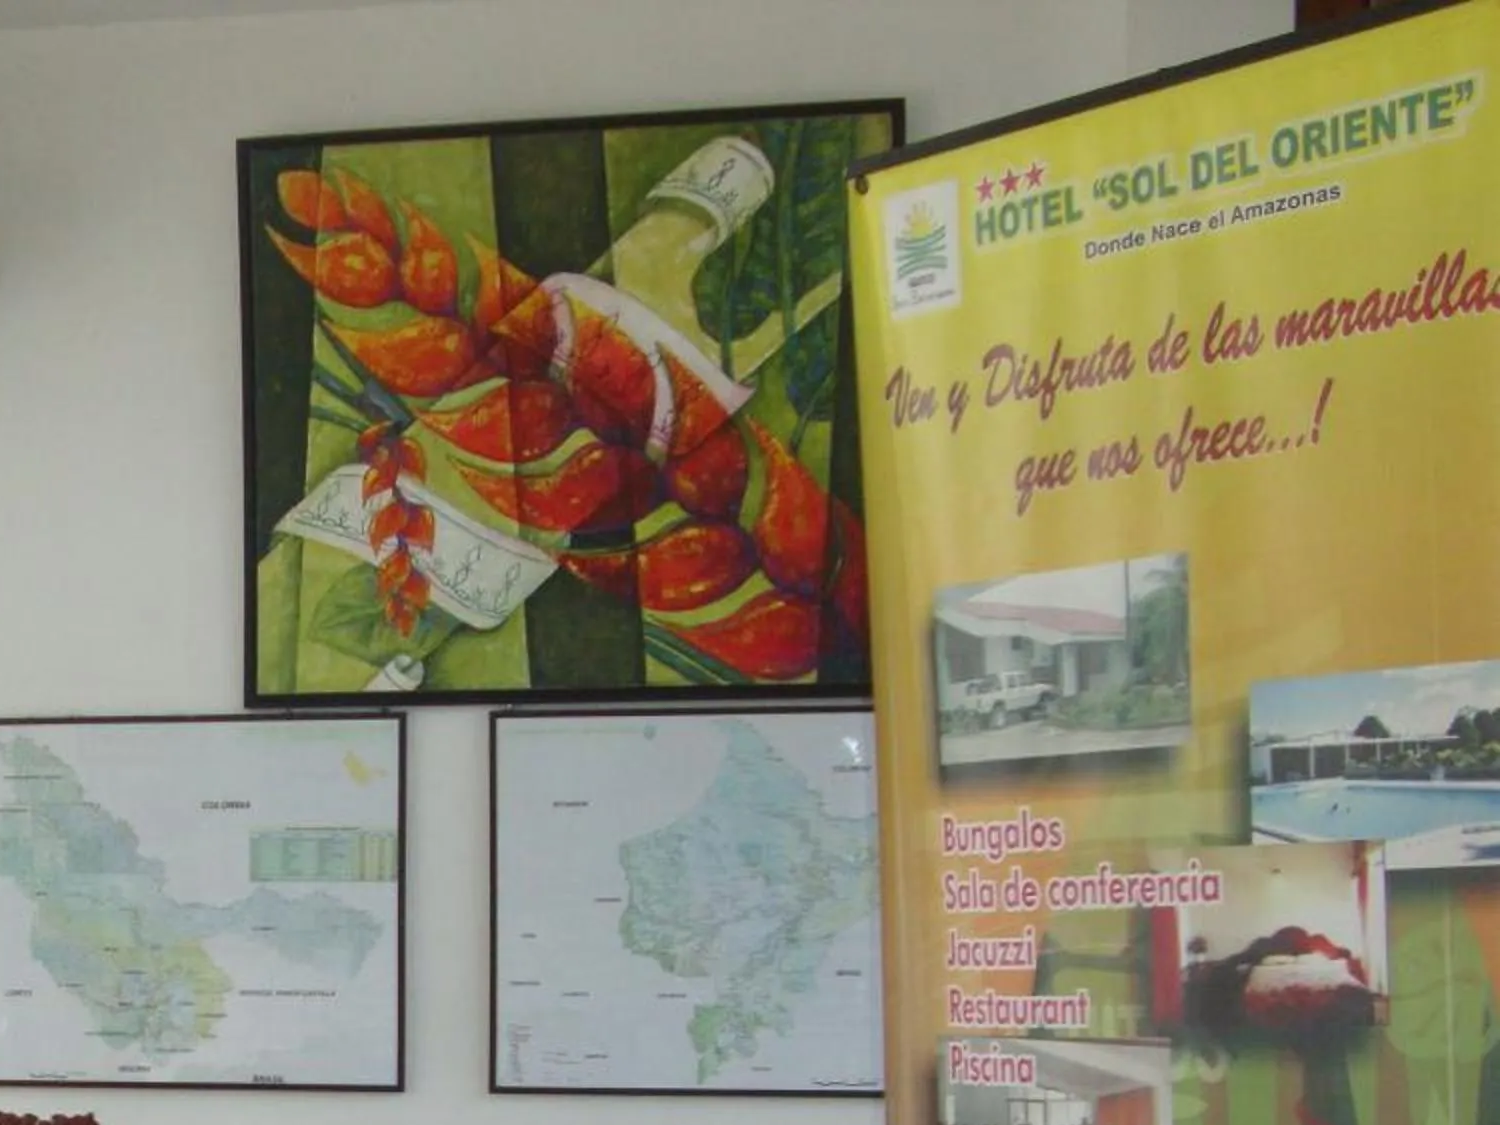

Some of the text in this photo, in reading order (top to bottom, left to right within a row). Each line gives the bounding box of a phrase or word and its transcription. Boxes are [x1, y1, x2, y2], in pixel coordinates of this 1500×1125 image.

[975, 185, 1083, 246] HOTEL
[1189, 139, 1260, 191] DEL
[1083, 184, 1342, 260] Donde Nace el Amazonas
[885, 364, 937, 428] Ven
[946, 380, 970, 434] y
[982, 336, 1137, 421] Disfruta
[1147, 311, 1191, 373] de
[1202, 300, 1265, 364] las
[1014, 448, 1078, 517] que
[1086, 435, 1143, 481] nos
[942, 808, 1064, 861] Bungalos
[943, 860, 1221, 911] Sala de conferencia
[947, 928, 1035, 968] Jacuzzi
[948, 987, 1089, 1026] Restaurant
[949, 1043, 1035, 1084] Piscina
